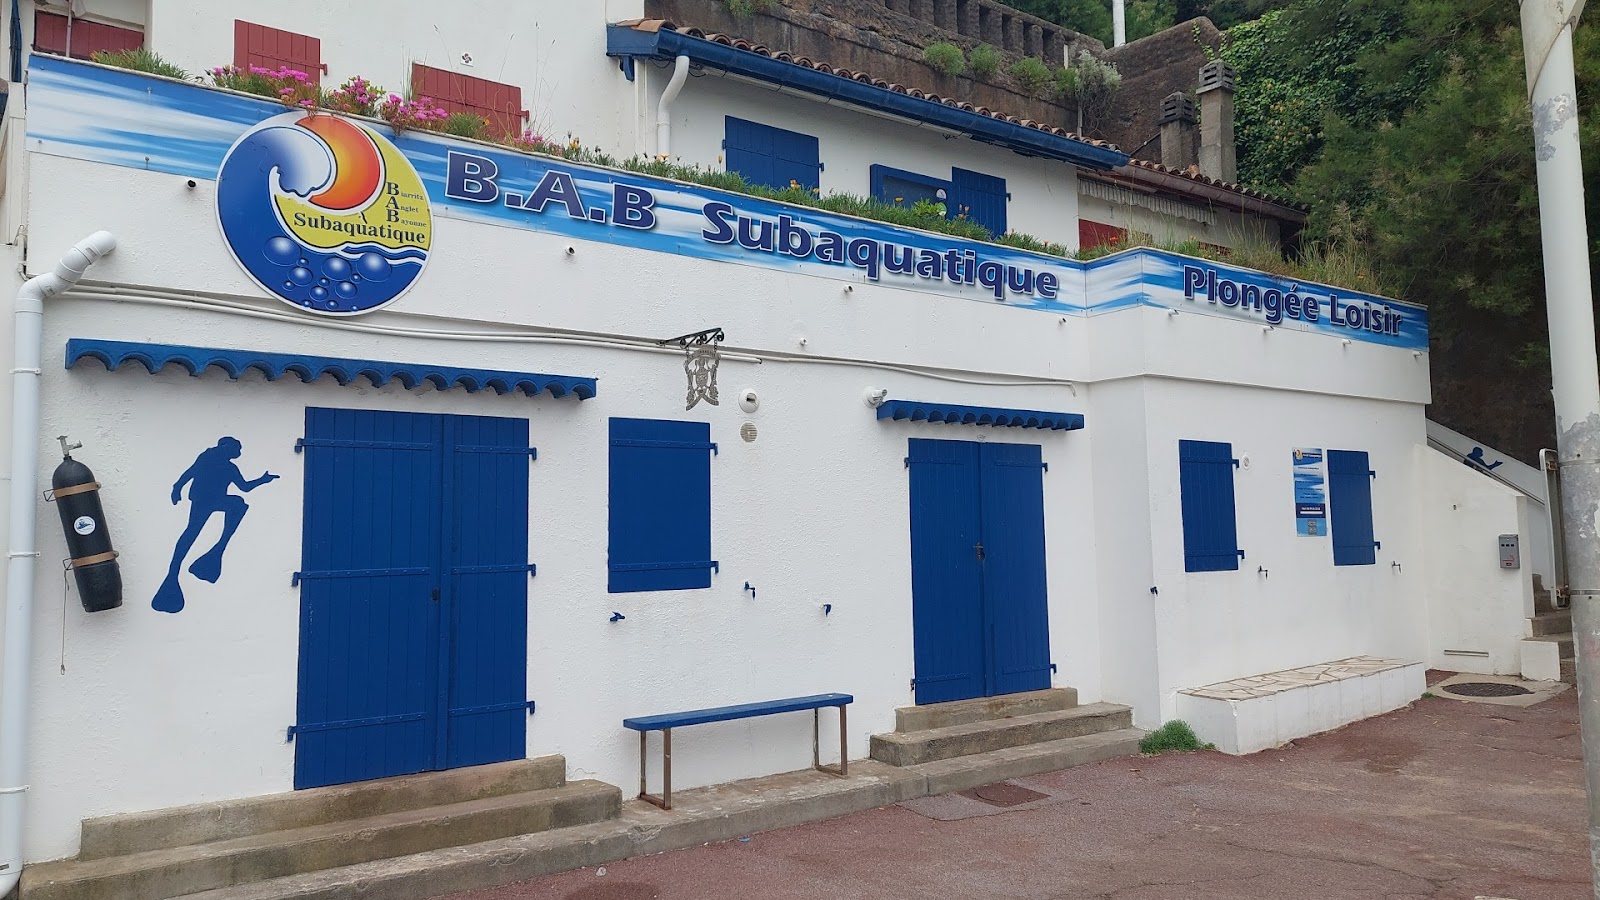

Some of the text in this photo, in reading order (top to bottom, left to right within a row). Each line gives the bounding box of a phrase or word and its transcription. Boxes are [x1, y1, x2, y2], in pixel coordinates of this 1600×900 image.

[294, 212, 426, 244] Subaquatique
[444, 150, 1060, 300] B.A.B Subaquatique
[1183, 264, 1403, 336] Plongée Loisir
